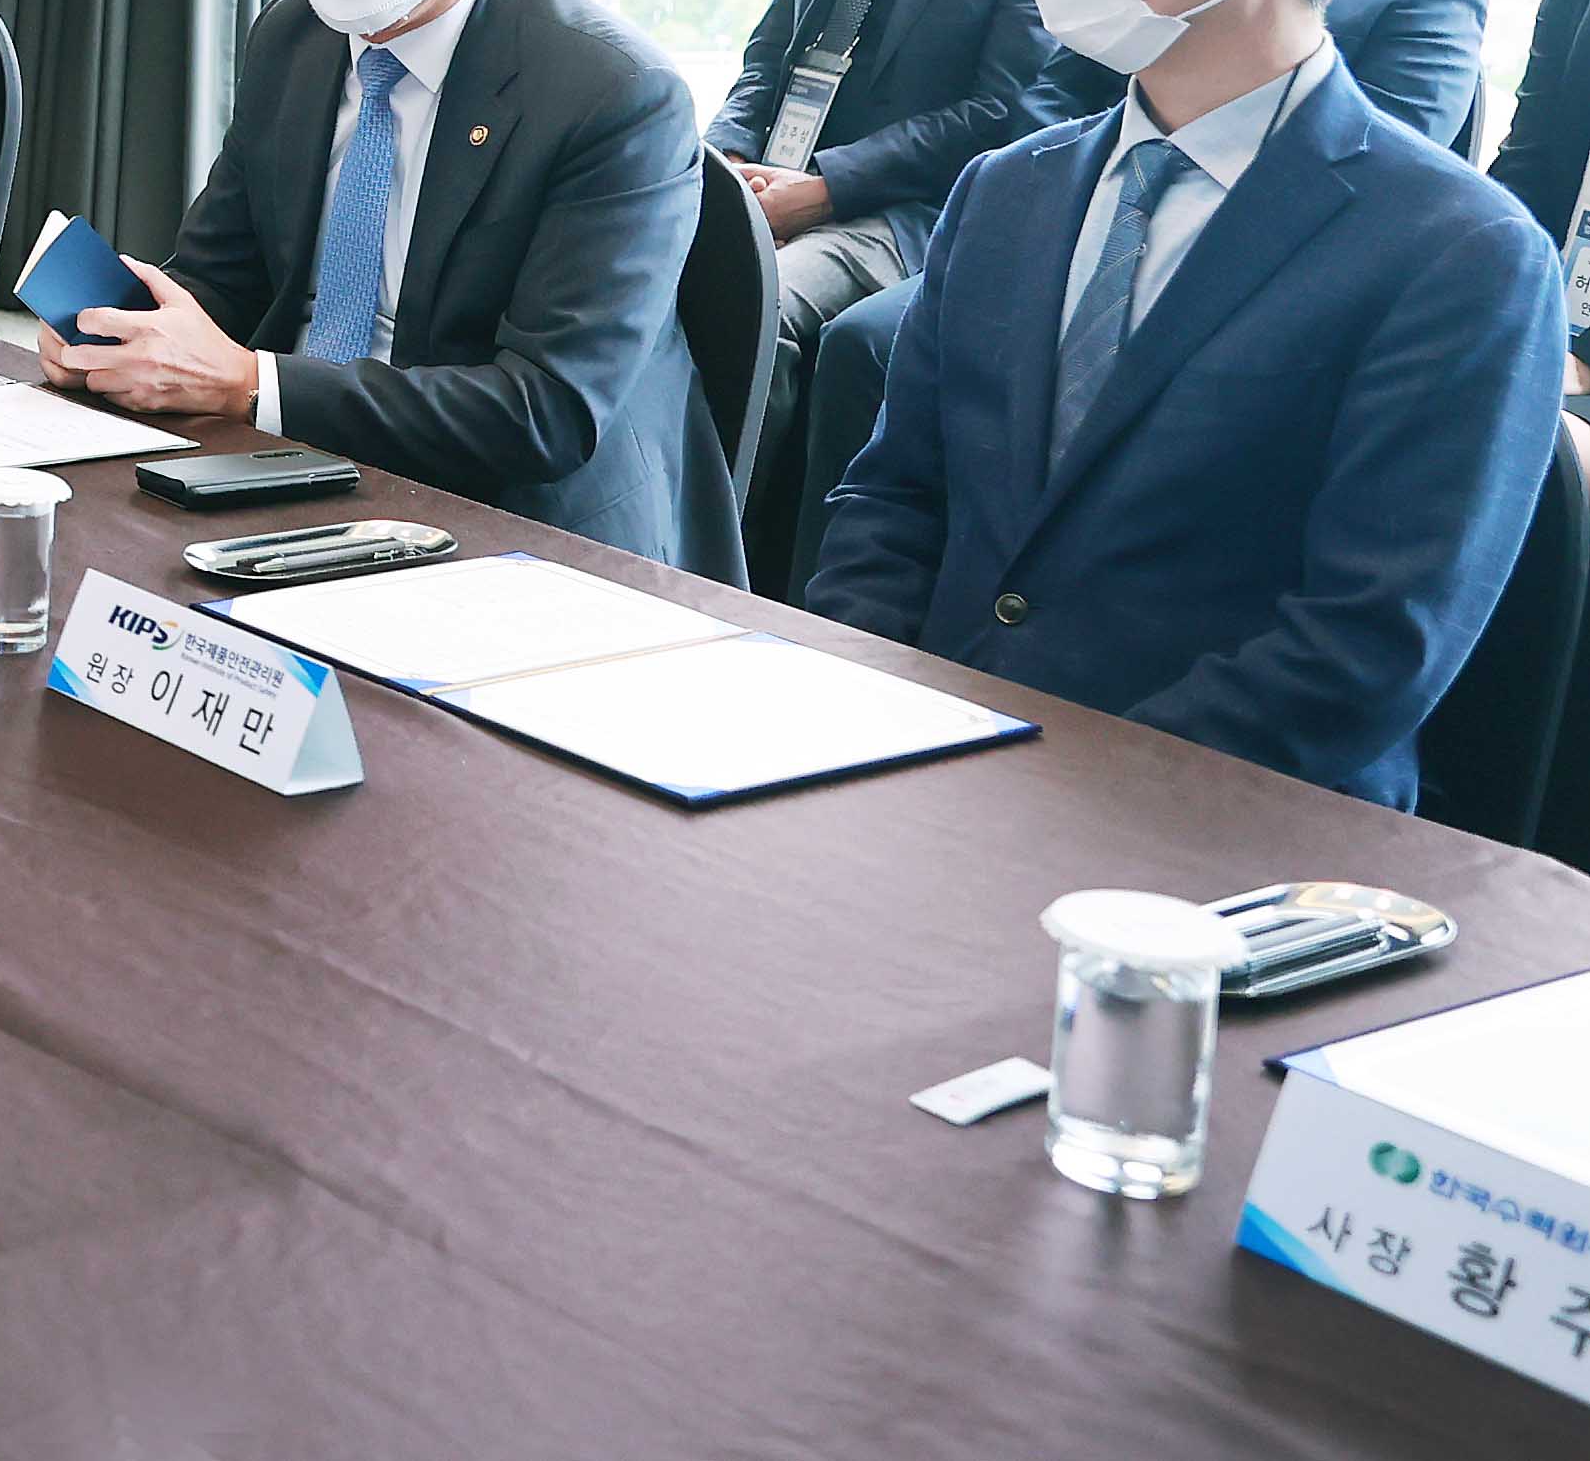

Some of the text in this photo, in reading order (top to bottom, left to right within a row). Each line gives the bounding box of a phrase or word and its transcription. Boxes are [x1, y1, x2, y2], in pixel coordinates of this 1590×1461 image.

[108, 604, 178, 651] KIPS
[86, 652, 135, 695] 원장
[1305, 1205, 1412, 1276] 사장
